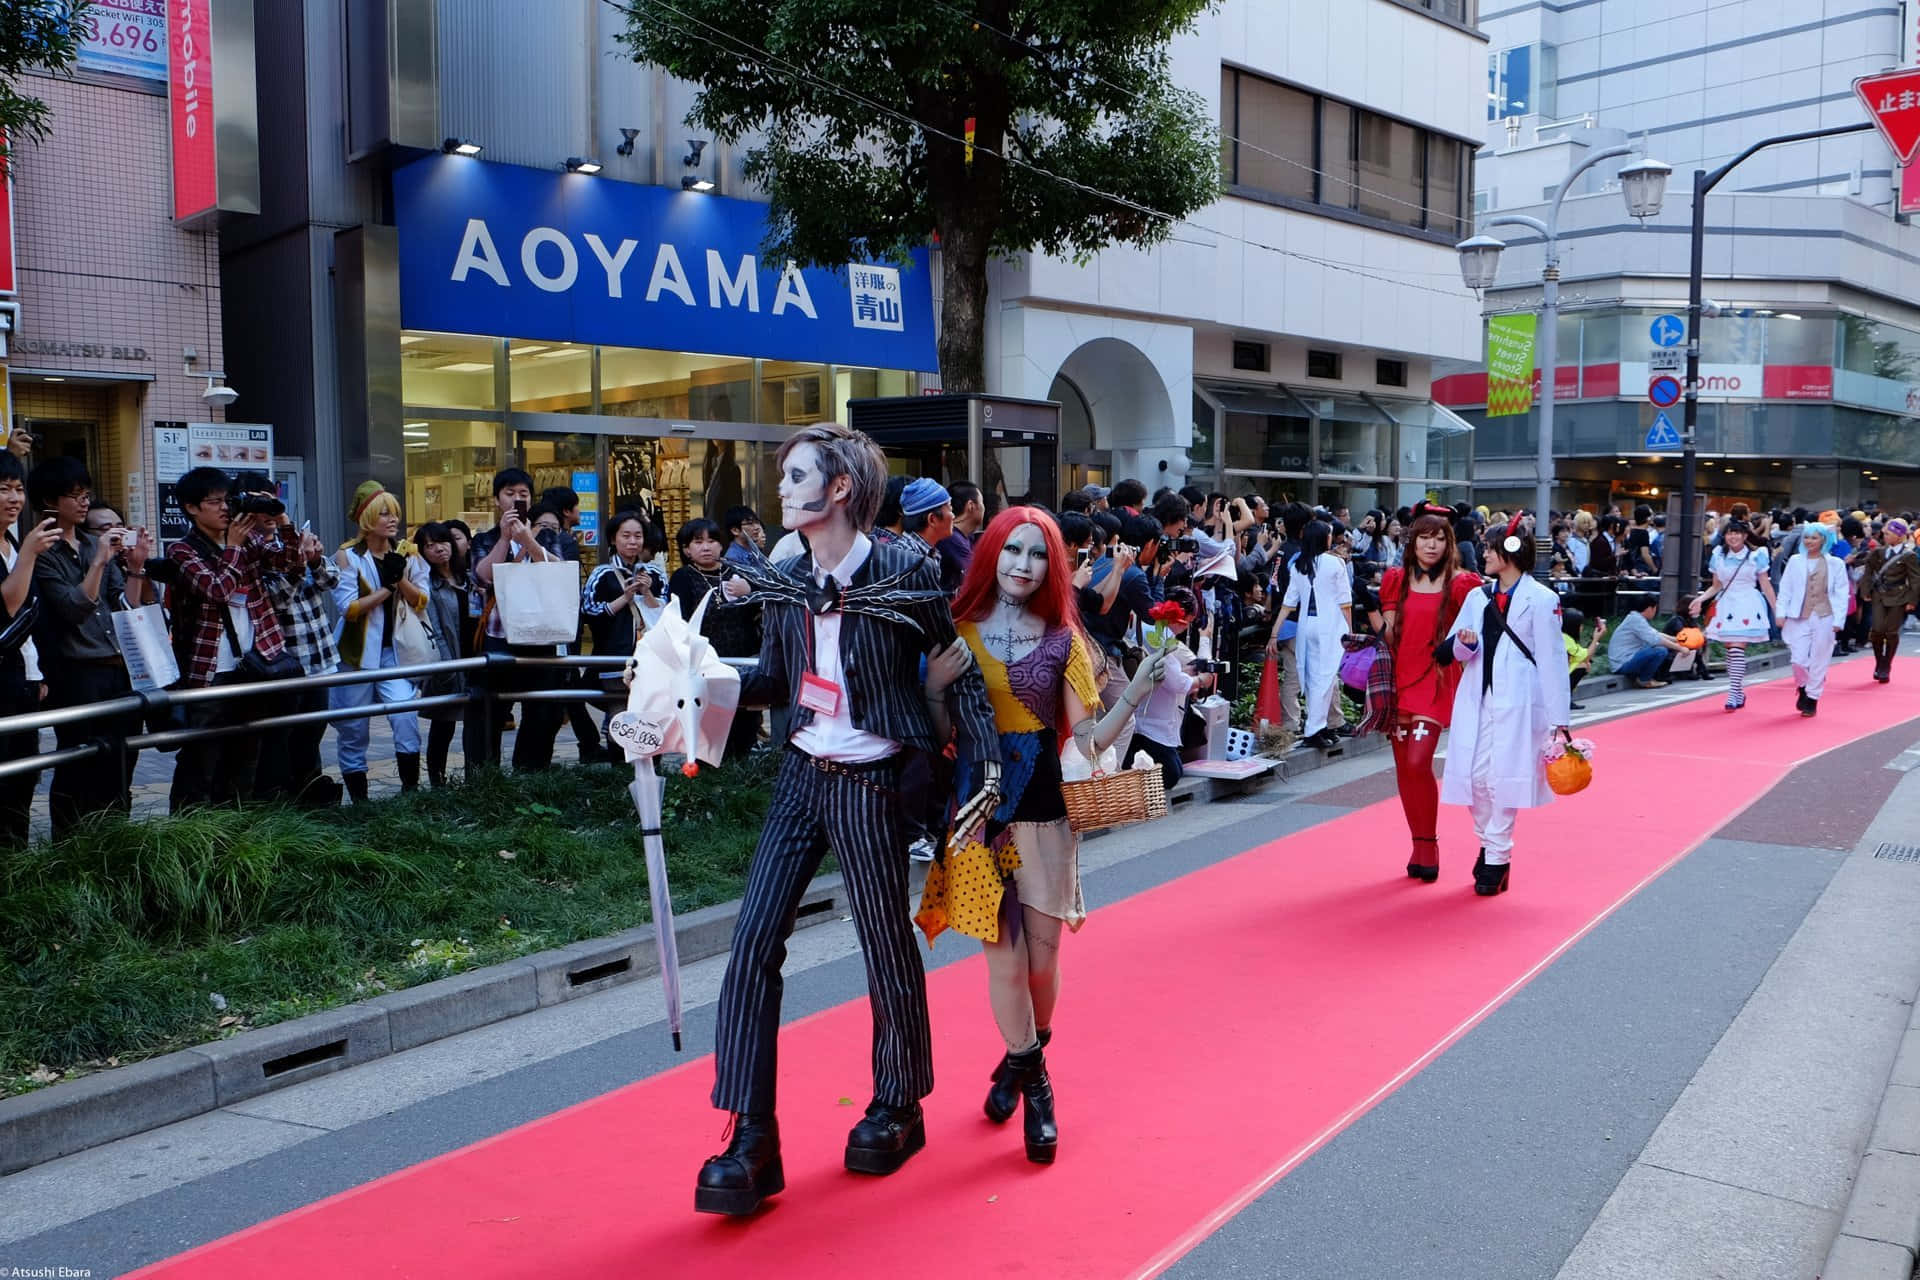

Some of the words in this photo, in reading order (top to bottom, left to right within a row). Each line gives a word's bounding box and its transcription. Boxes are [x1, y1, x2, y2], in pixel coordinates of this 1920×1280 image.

[84, 17, 158, 52] 3,696
[1877, 89, 1920, 112] 止ま
[450, 218, 818, 319] AOYAMA
[855, 271, 896, 291] 洋服の
[856, 294, 899, 323] 青山
[112, 346, 153, 361] BLD.
